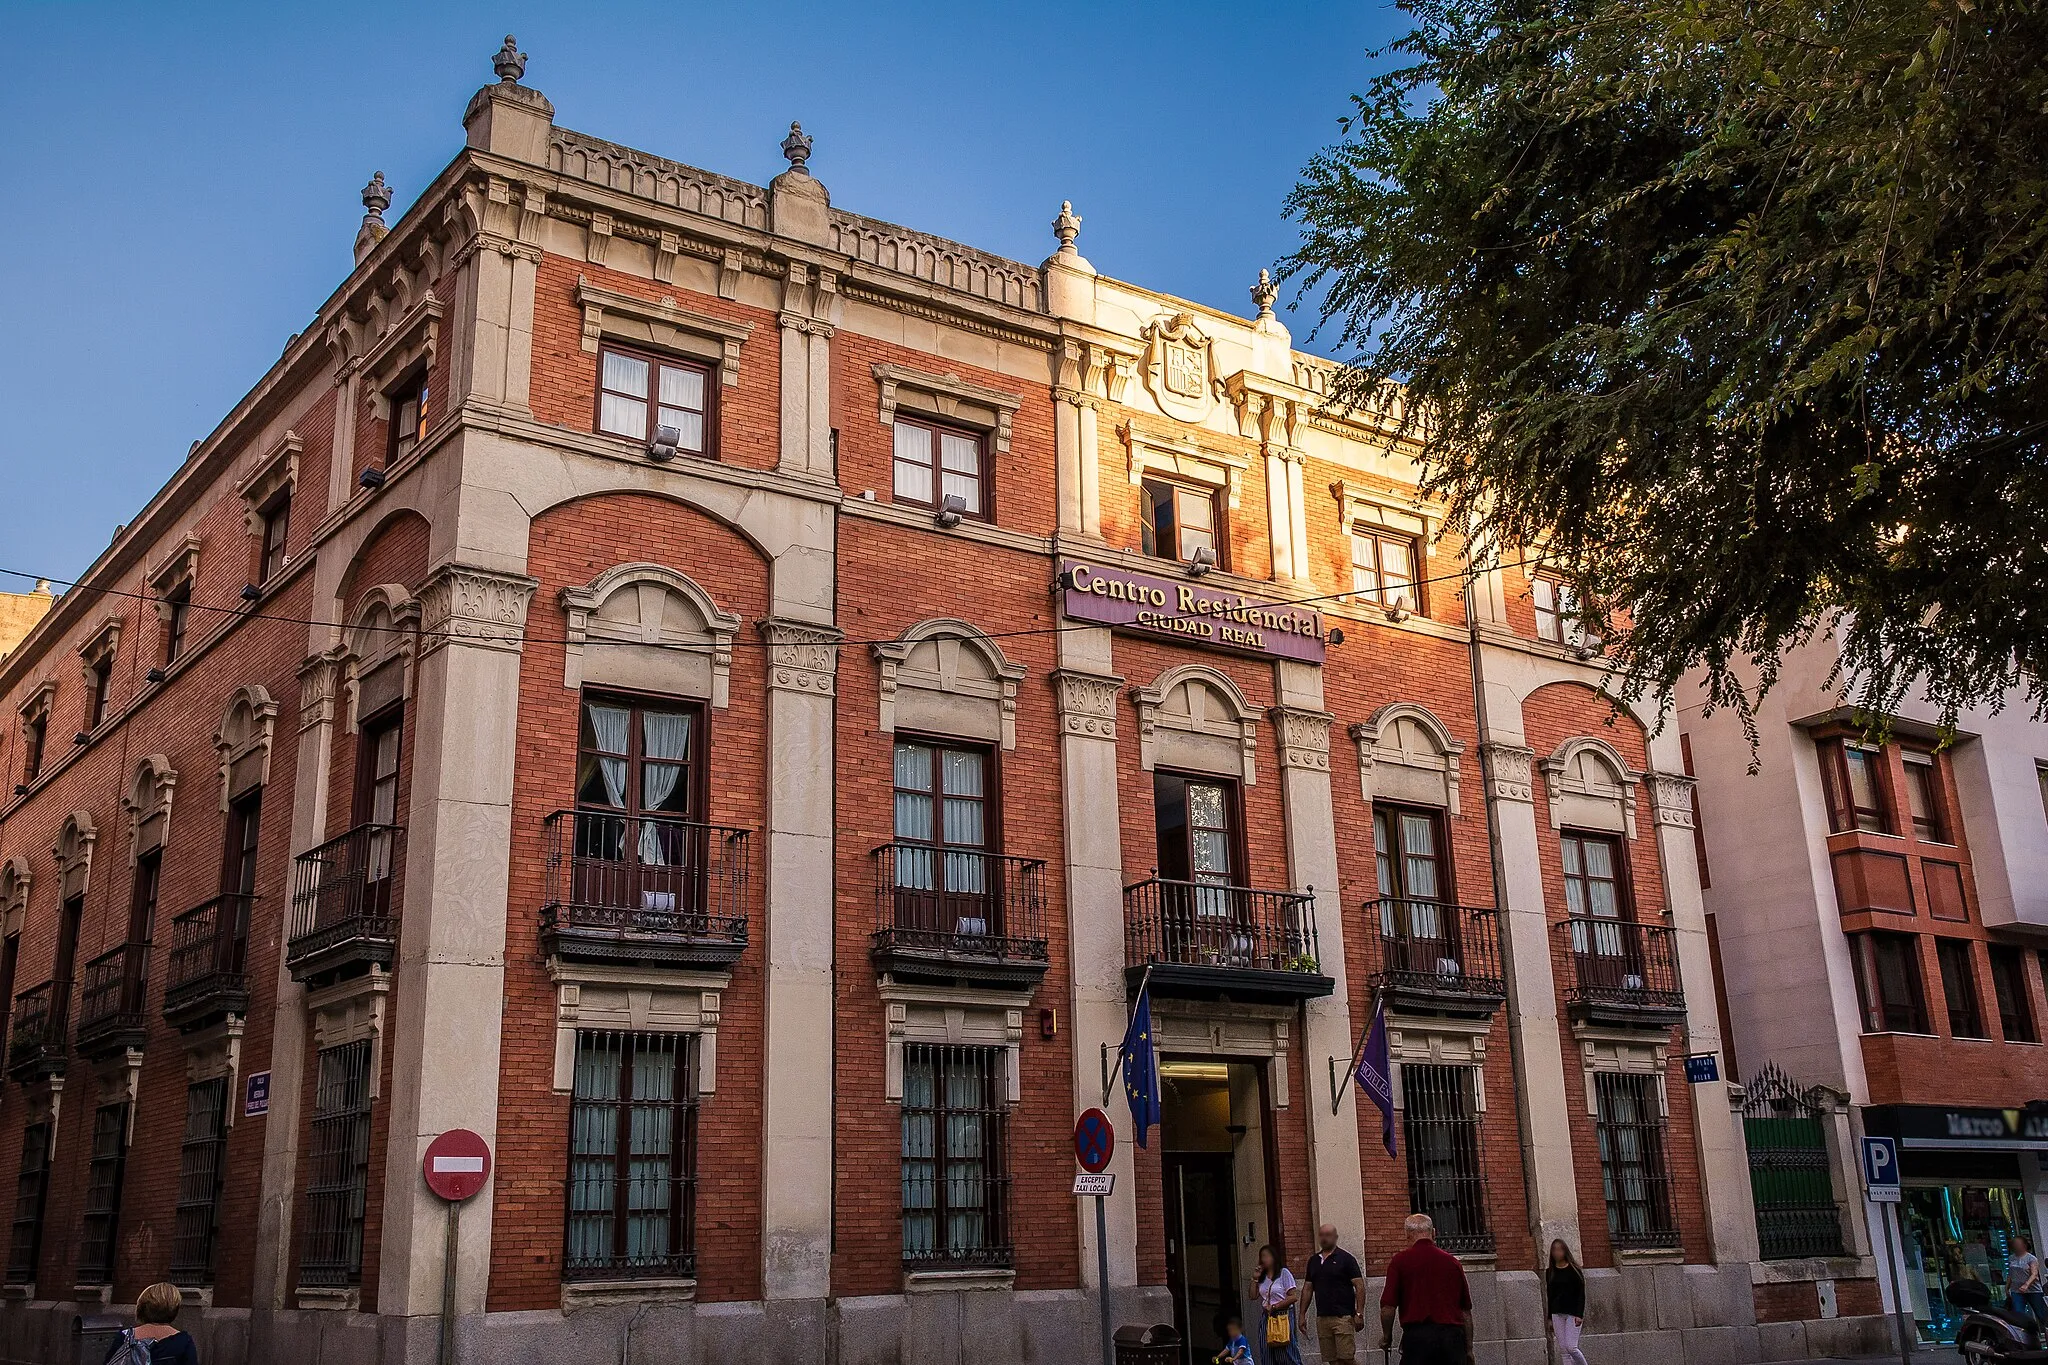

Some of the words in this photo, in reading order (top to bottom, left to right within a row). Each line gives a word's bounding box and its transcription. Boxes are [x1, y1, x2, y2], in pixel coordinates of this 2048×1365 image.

[1072, 564, 1166, 607] Centro
[1177, 585, 1324, 638] Residencial
[1138, 611, 1214, 637] CIUDAD
[1221, 626, 1267, 648] REAL
[1213, 1026, 1221, 1047] 1
[1360, 1062, 1389, 1097] HOTELES
[1946, 1113, 2004, 1137] Marco
[1870, 1143, 1890, 1179] P
[1075, 1184, 1089, 1192] TAXI
[1090, 1184, 1108, 1192] LOCAL
[1080, 1176, 1106, 1184] EXCEPTO
